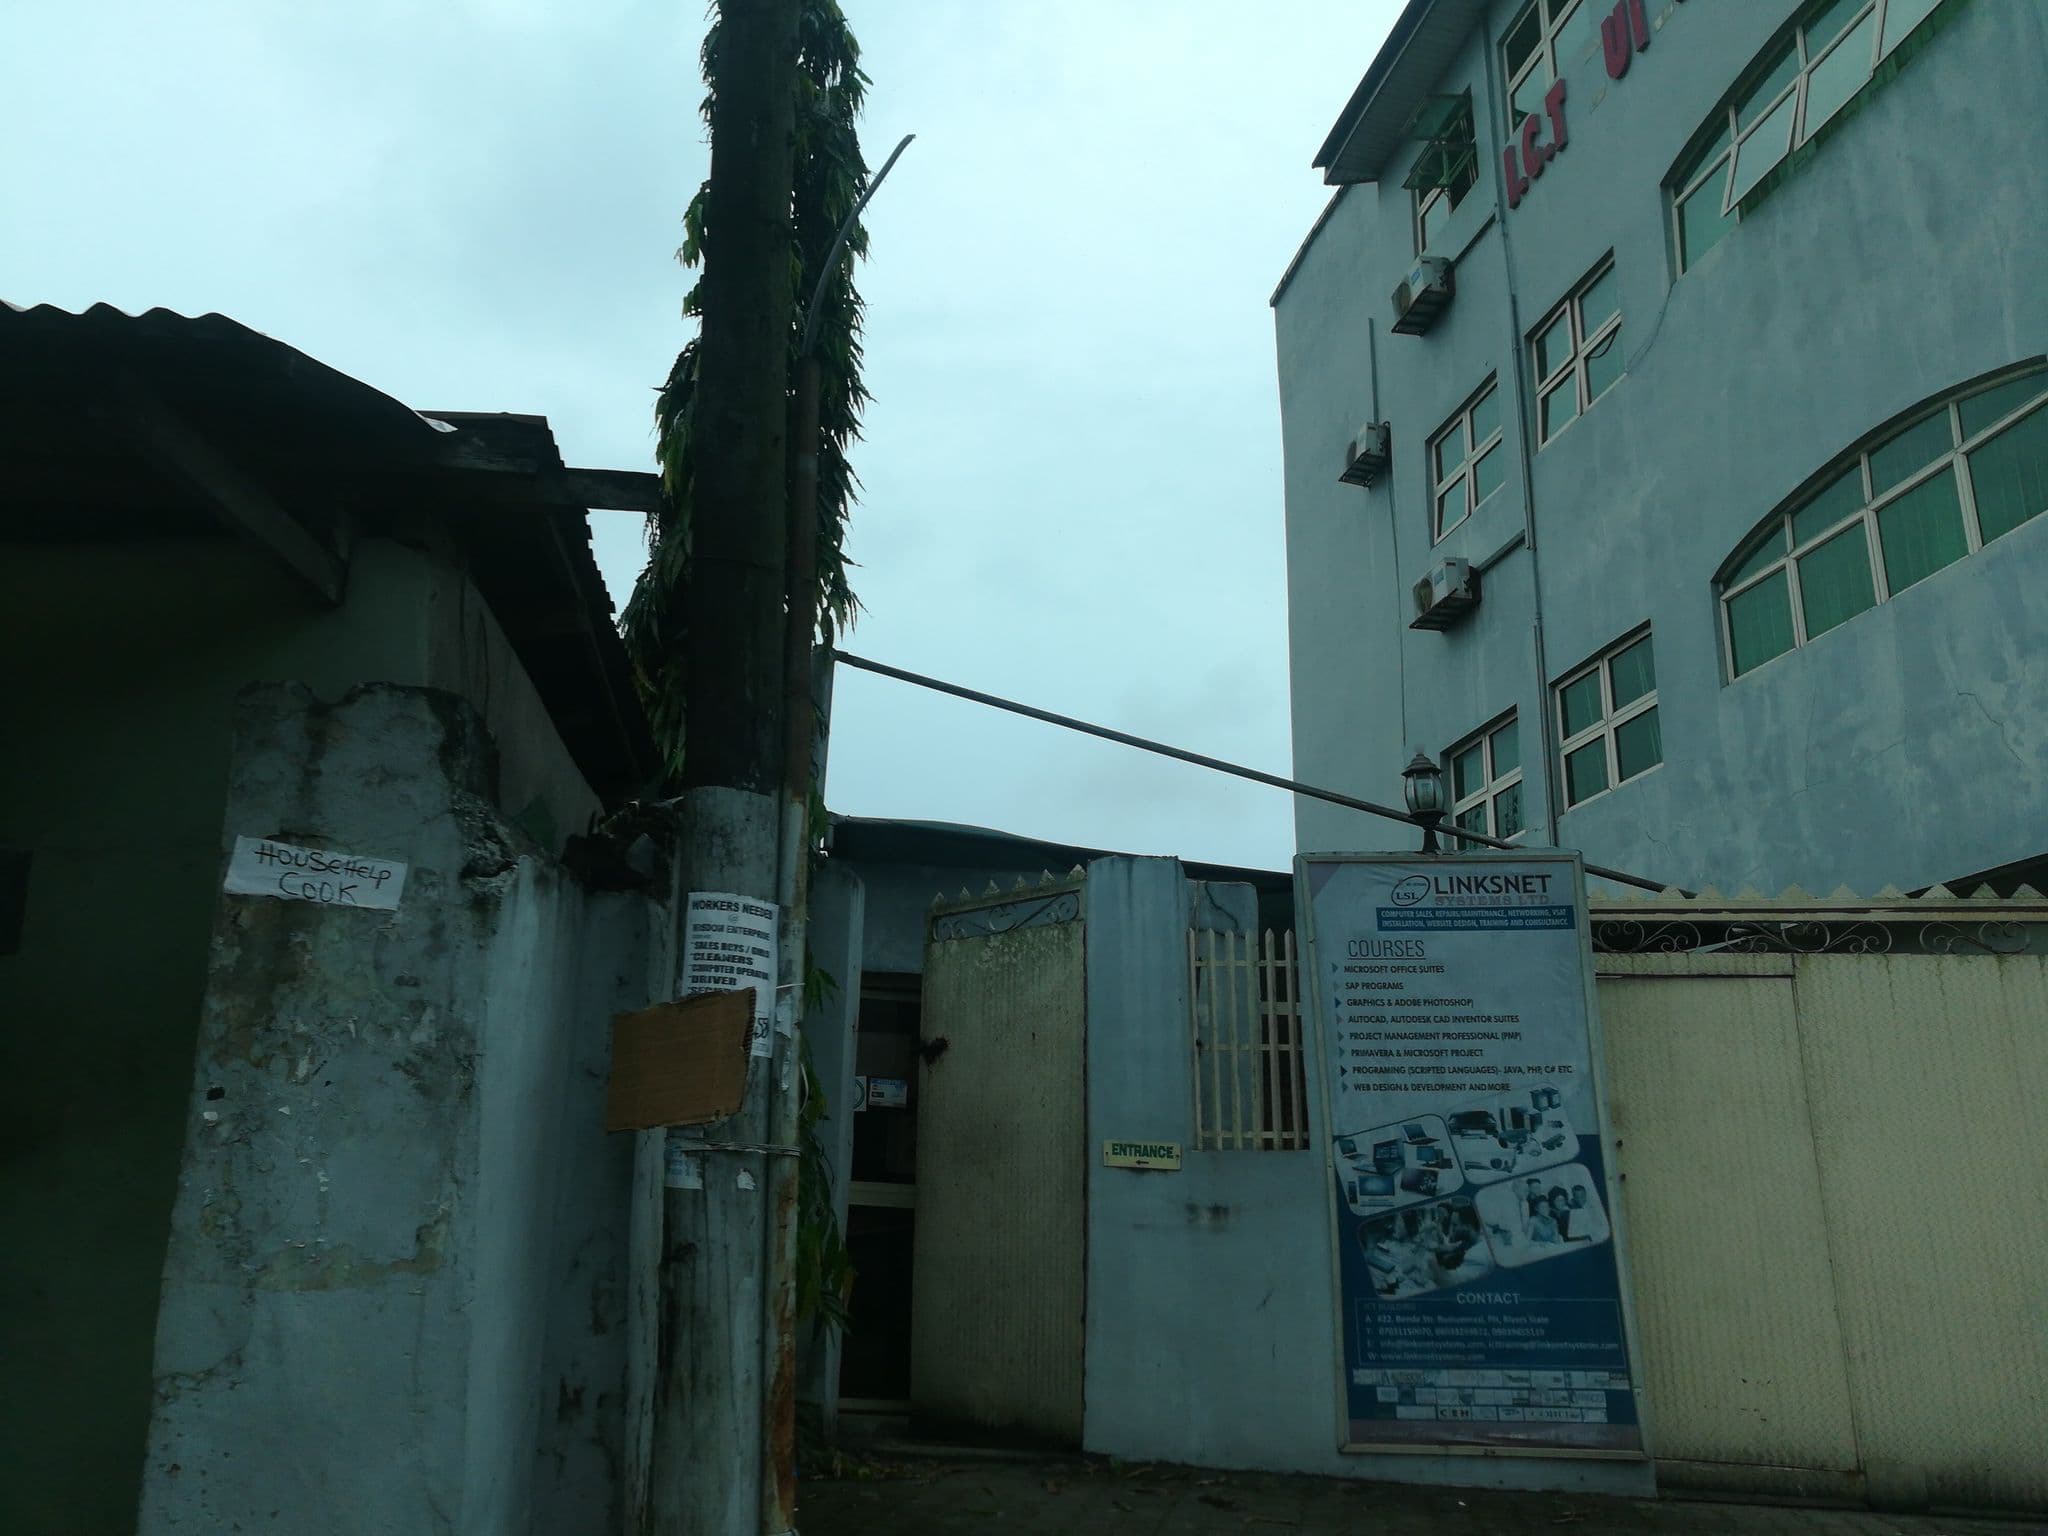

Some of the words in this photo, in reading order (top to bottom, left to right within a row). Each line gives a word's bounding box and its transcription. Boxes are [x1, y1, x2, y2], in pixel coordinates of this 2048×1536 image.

[278, 872, 359, 904] COOK
[1433, 874, 1552, 895] LINKSNET
[1396, 891, 1419, 901] LSL
[1435, 895, 1513, 906] SYSTEMS
[692, 900, 740, 912] WORKERS
[742, 903, 773, 920] NEEDED
[1381, 910, 1415, 918] COMPUTER
[1426, 919, 1452, 927] WEBSITE
[1479, 919, 1509, 927] TRAINING
[1510, 919, 1524, 927] AND
[1348, 939, 1425, 957] COURSES
[1344, 965, 1388, 973] MICROSOFT
[1390, 965, 1417, 973] OFFICE
[1418, 965, 1445, 973] SUITES
[1345, 982, 1360, 990] SAP
[1361, 982, 1404, 990] PROGRAMS
[1346, 998, 1385, 1007] GRAPHICS
[1387, 998, 1392, 1006] &
[1394, 998, 1422, 1006] ADOBE
[1348, 1015, 1389, 1024] AUTOCAD,
[1390, 1015, 1432, 1023] AUTODESK
[1433, 1015, 1450, 1023] CAD
[1452, 1015, 1493, 1023] INVENTOR
[1493, 1015, 1520, 1023] SUITES
[1349, 1032, 1383, 1040] PROJECT
[1384, 1032, 1440, 1040] MANAGEMENT
[1442, 1032, 1500, 1040] PROFESSIONAL
[1501, 1032, 1522, 1041] (PMP)
[1351, 1049, 1395, 1057] PRIMAVERA
[1396, 1049, 1402, 1057] &
[1403, 1049, 1448, 1057] MICROSOFT
[1450, 1049, 1484, 1057] PROJECT
[1352, 1066, 1406, 1074] PROGRAMING
[1408, 1066, 1446, 1075] (SCRIPTED
[1544, 1065, 1556, 1073] C#
[1557, 1065, 1573, 1073] ETC
[1353, 1083, 1371, 1091] WEB
[1373, 1083, 1404, 1091] DESIGN
[1404, 1083, 1409, 1091] &
[1411, 1083, 1467, 1091] DEVELOPMENT
[1468, 1083, 1487, 1091] AND
[1487, 1083, 1511, 1091] MORE
[1111, 1143, 1174, 1159] ENTRANCE
[1456, 1292, 1520, 1304] CONTACT
